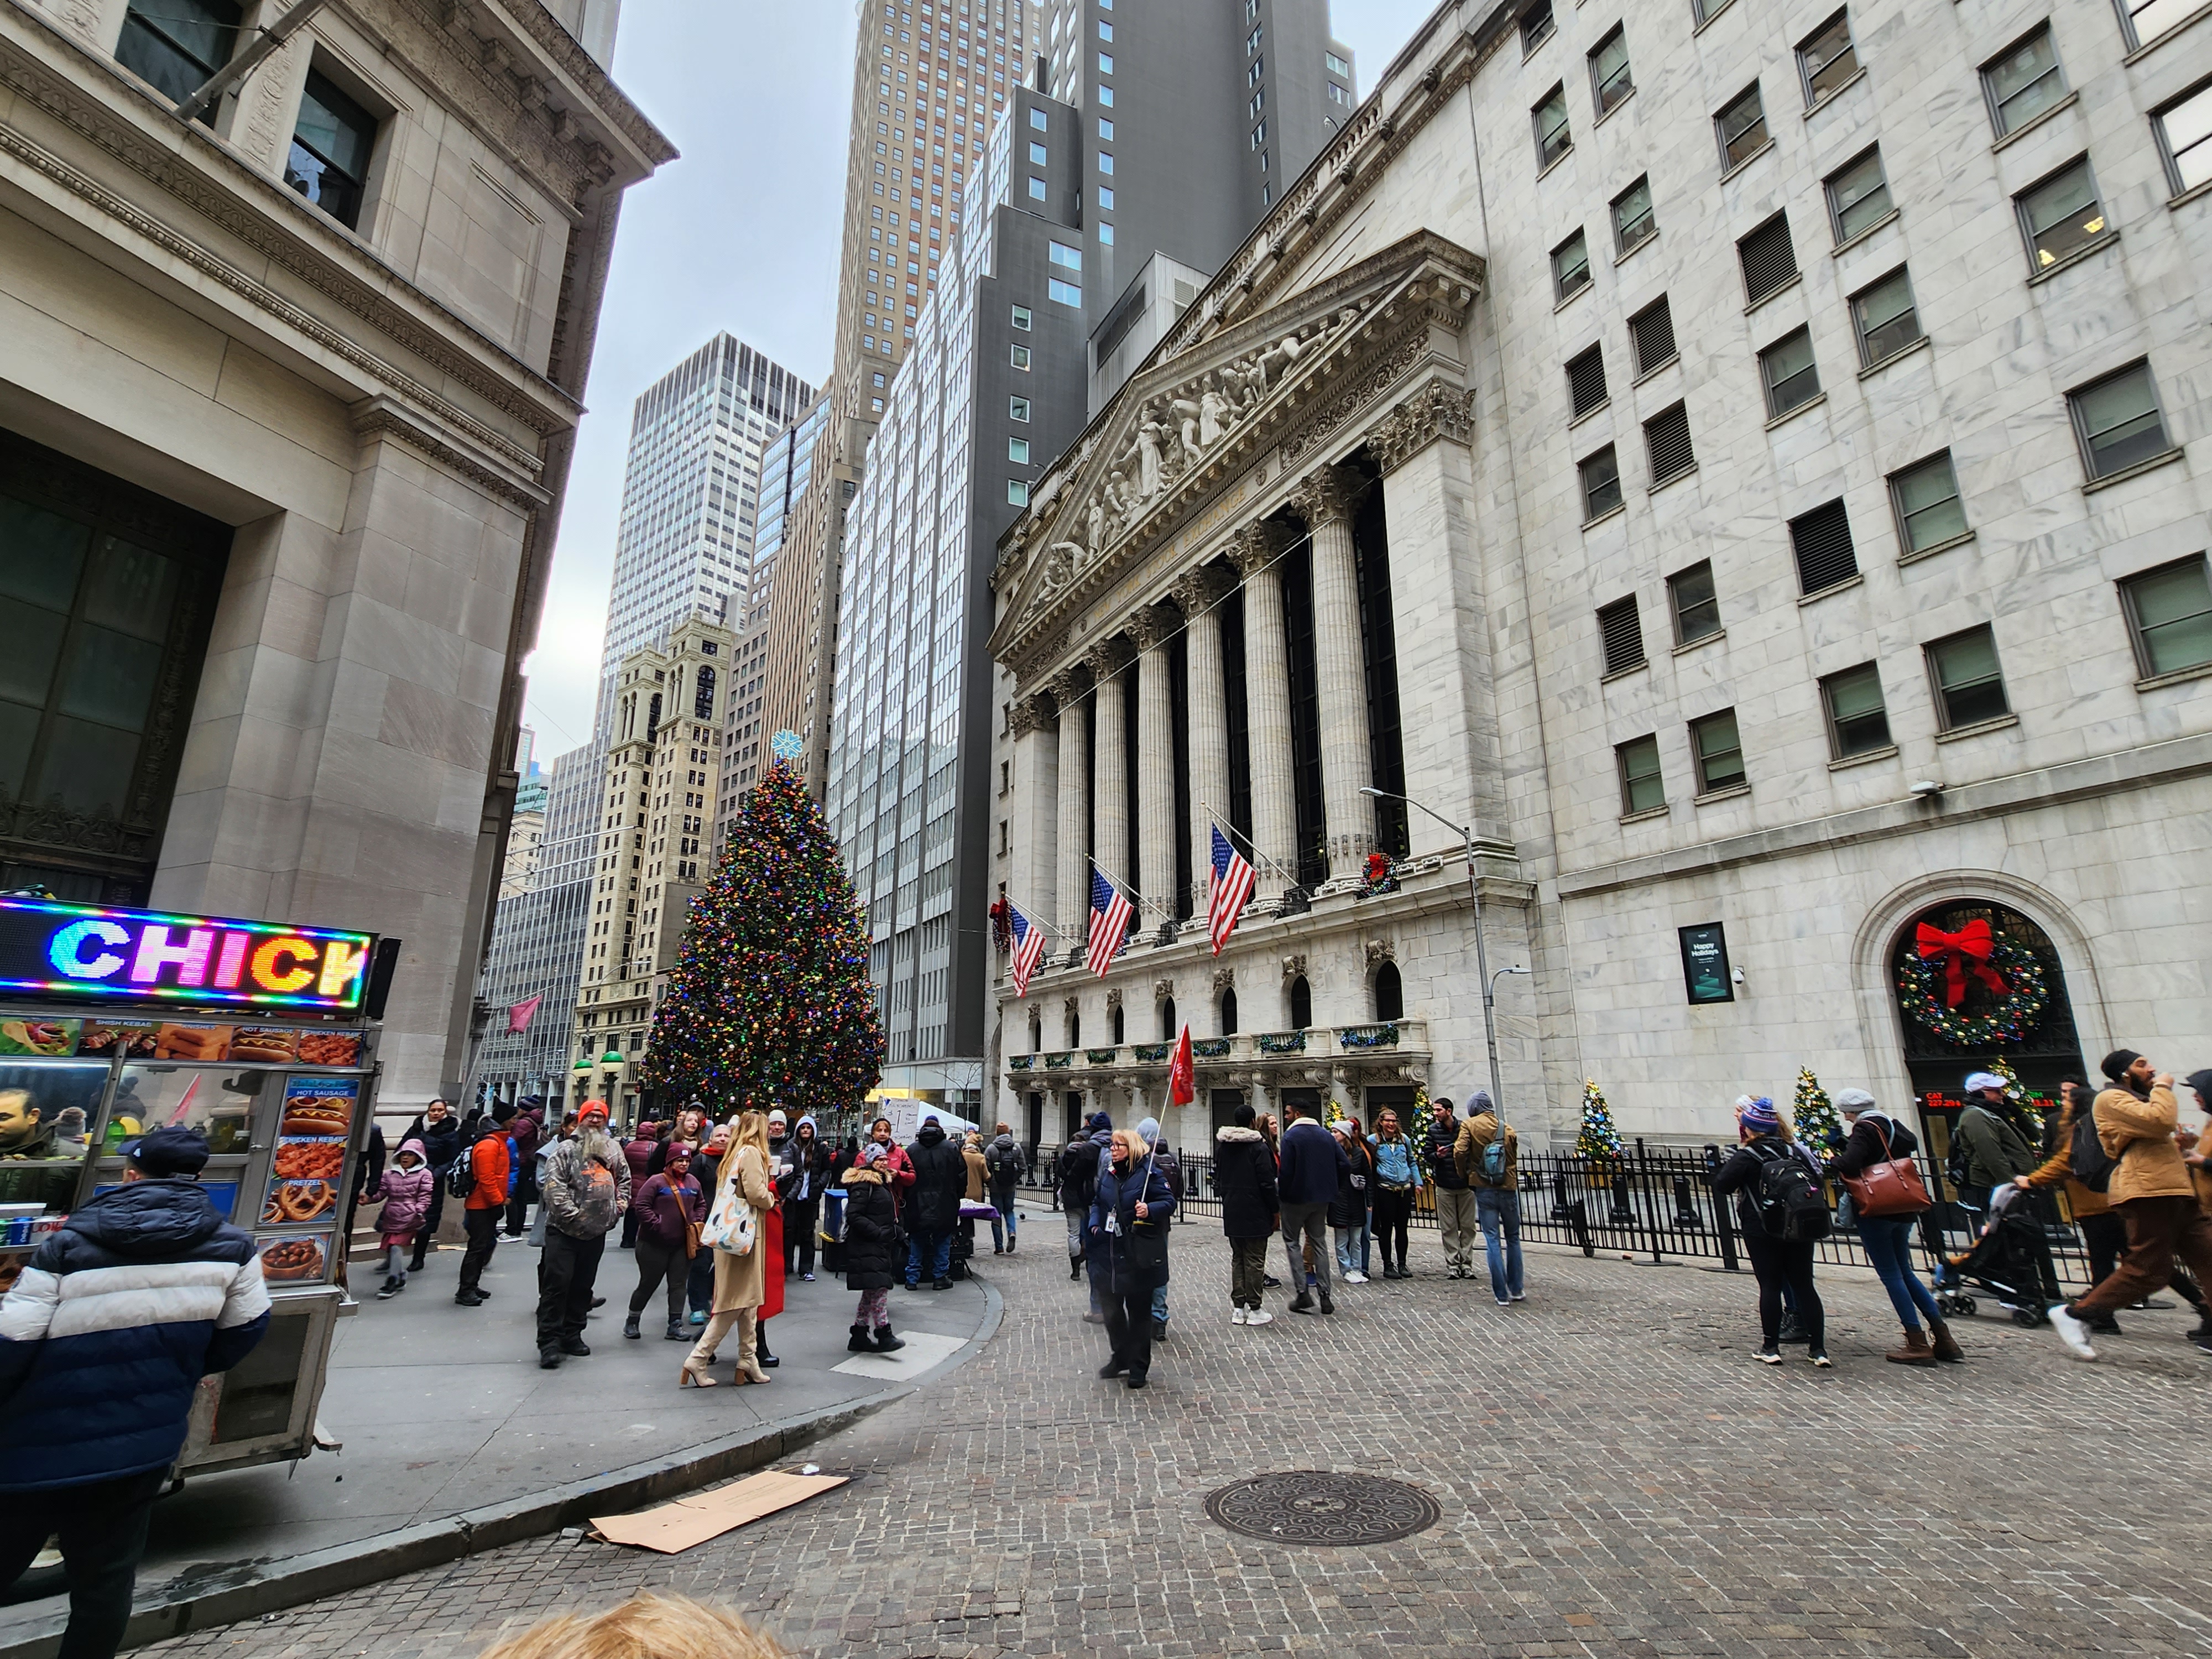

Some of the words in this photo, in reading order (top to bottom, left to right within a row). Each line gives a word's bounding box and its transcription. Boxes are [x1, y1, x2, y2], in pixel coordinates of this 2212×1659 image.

[1094, 597, 1112, 622] NEW
[1116, 574, 1141, 603] YORK
[1146, 544, 1178, 578] STOCK
[1182, 485, 1247, 549] EXCHANGE
